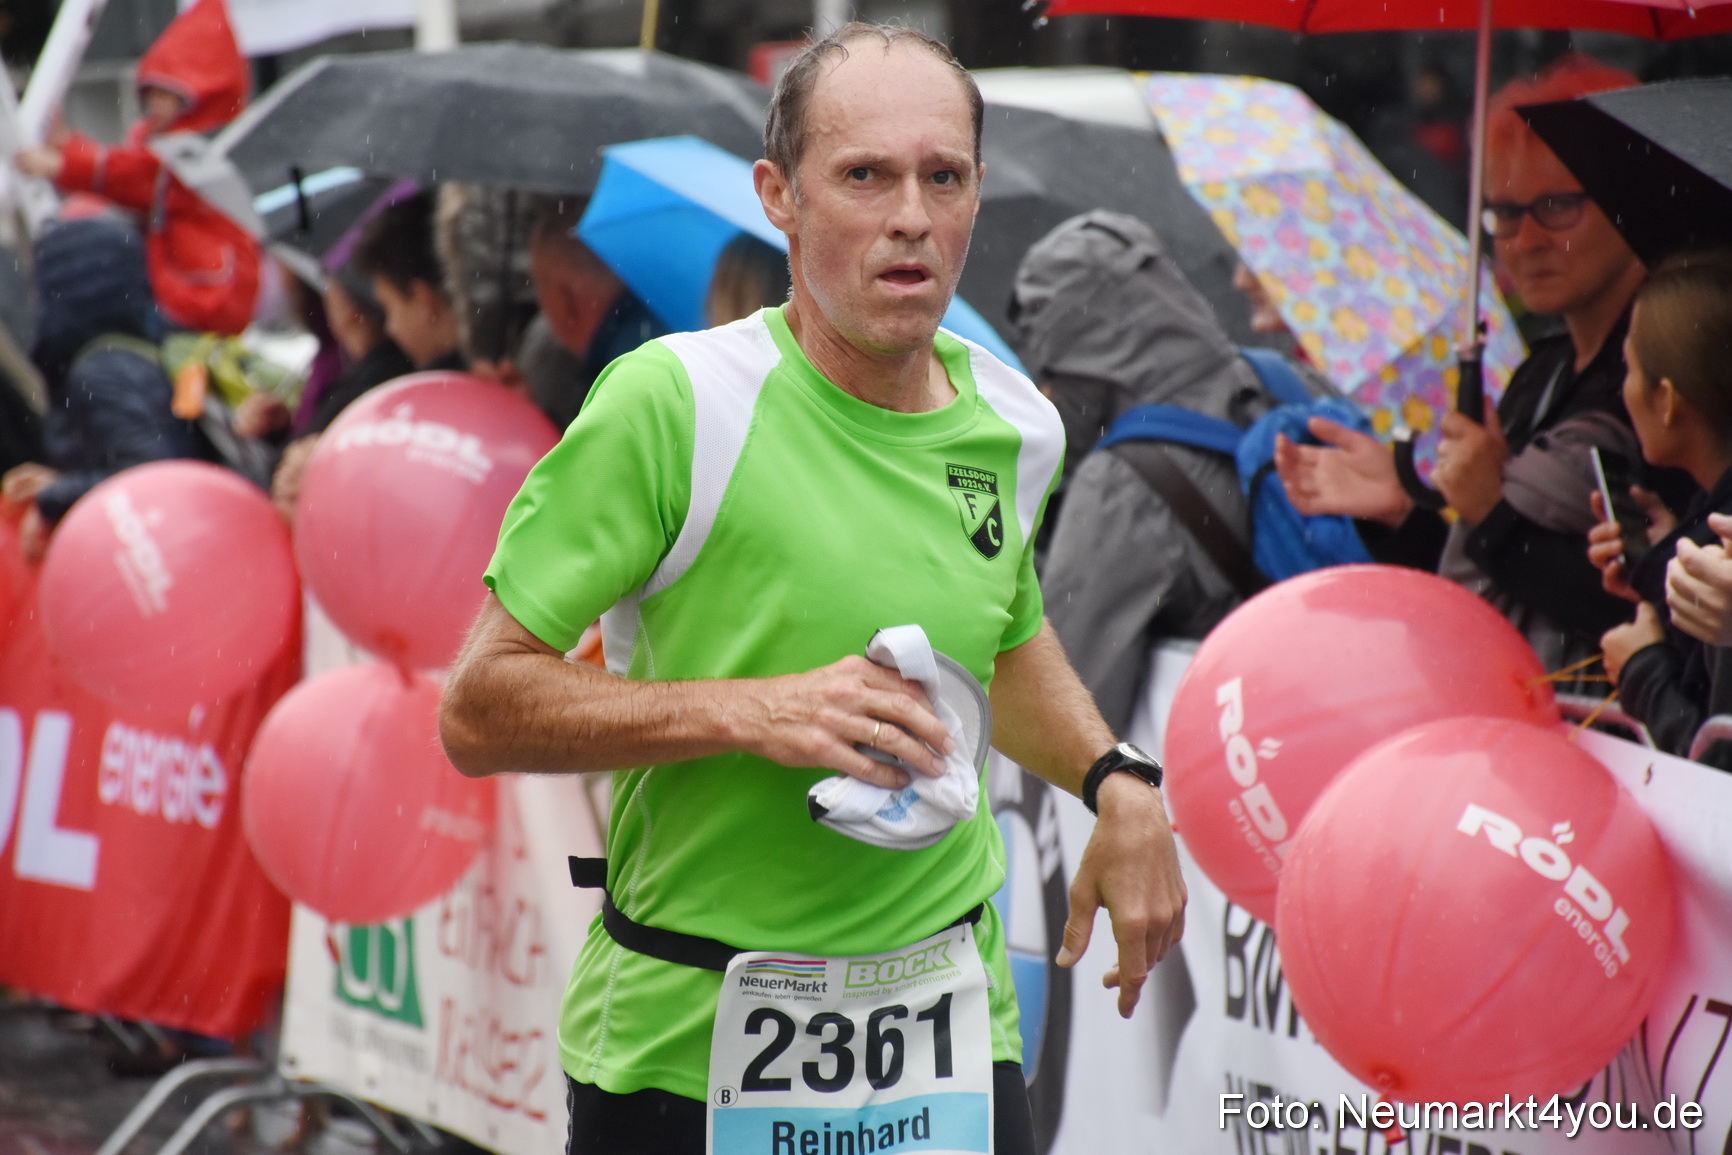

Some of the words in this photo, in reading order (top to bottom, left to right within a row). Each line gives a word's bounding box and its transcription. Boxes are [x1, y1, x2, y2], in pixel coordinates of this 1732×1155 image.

[948, 466, 996, 485] EZELSDORF
[962, 492, 977, 520] F
[987, 517, 1001, 547] C
[1554, 897, 1618, 979] energie
[845, 940, 957, 987] BOCK
[739, 976, 828, 993] NeuerMarkt
[842, 988, 878, 999] inspired
[881, 985, 893, 995] by
[894, 980, 918, 993] smart
[918, 970, 962, 987] concepts
[741, 992, 954, 1093] 2361
[721, 1089, 731, 1104] B
[772, 1106, 931, 1155] Reinhard
